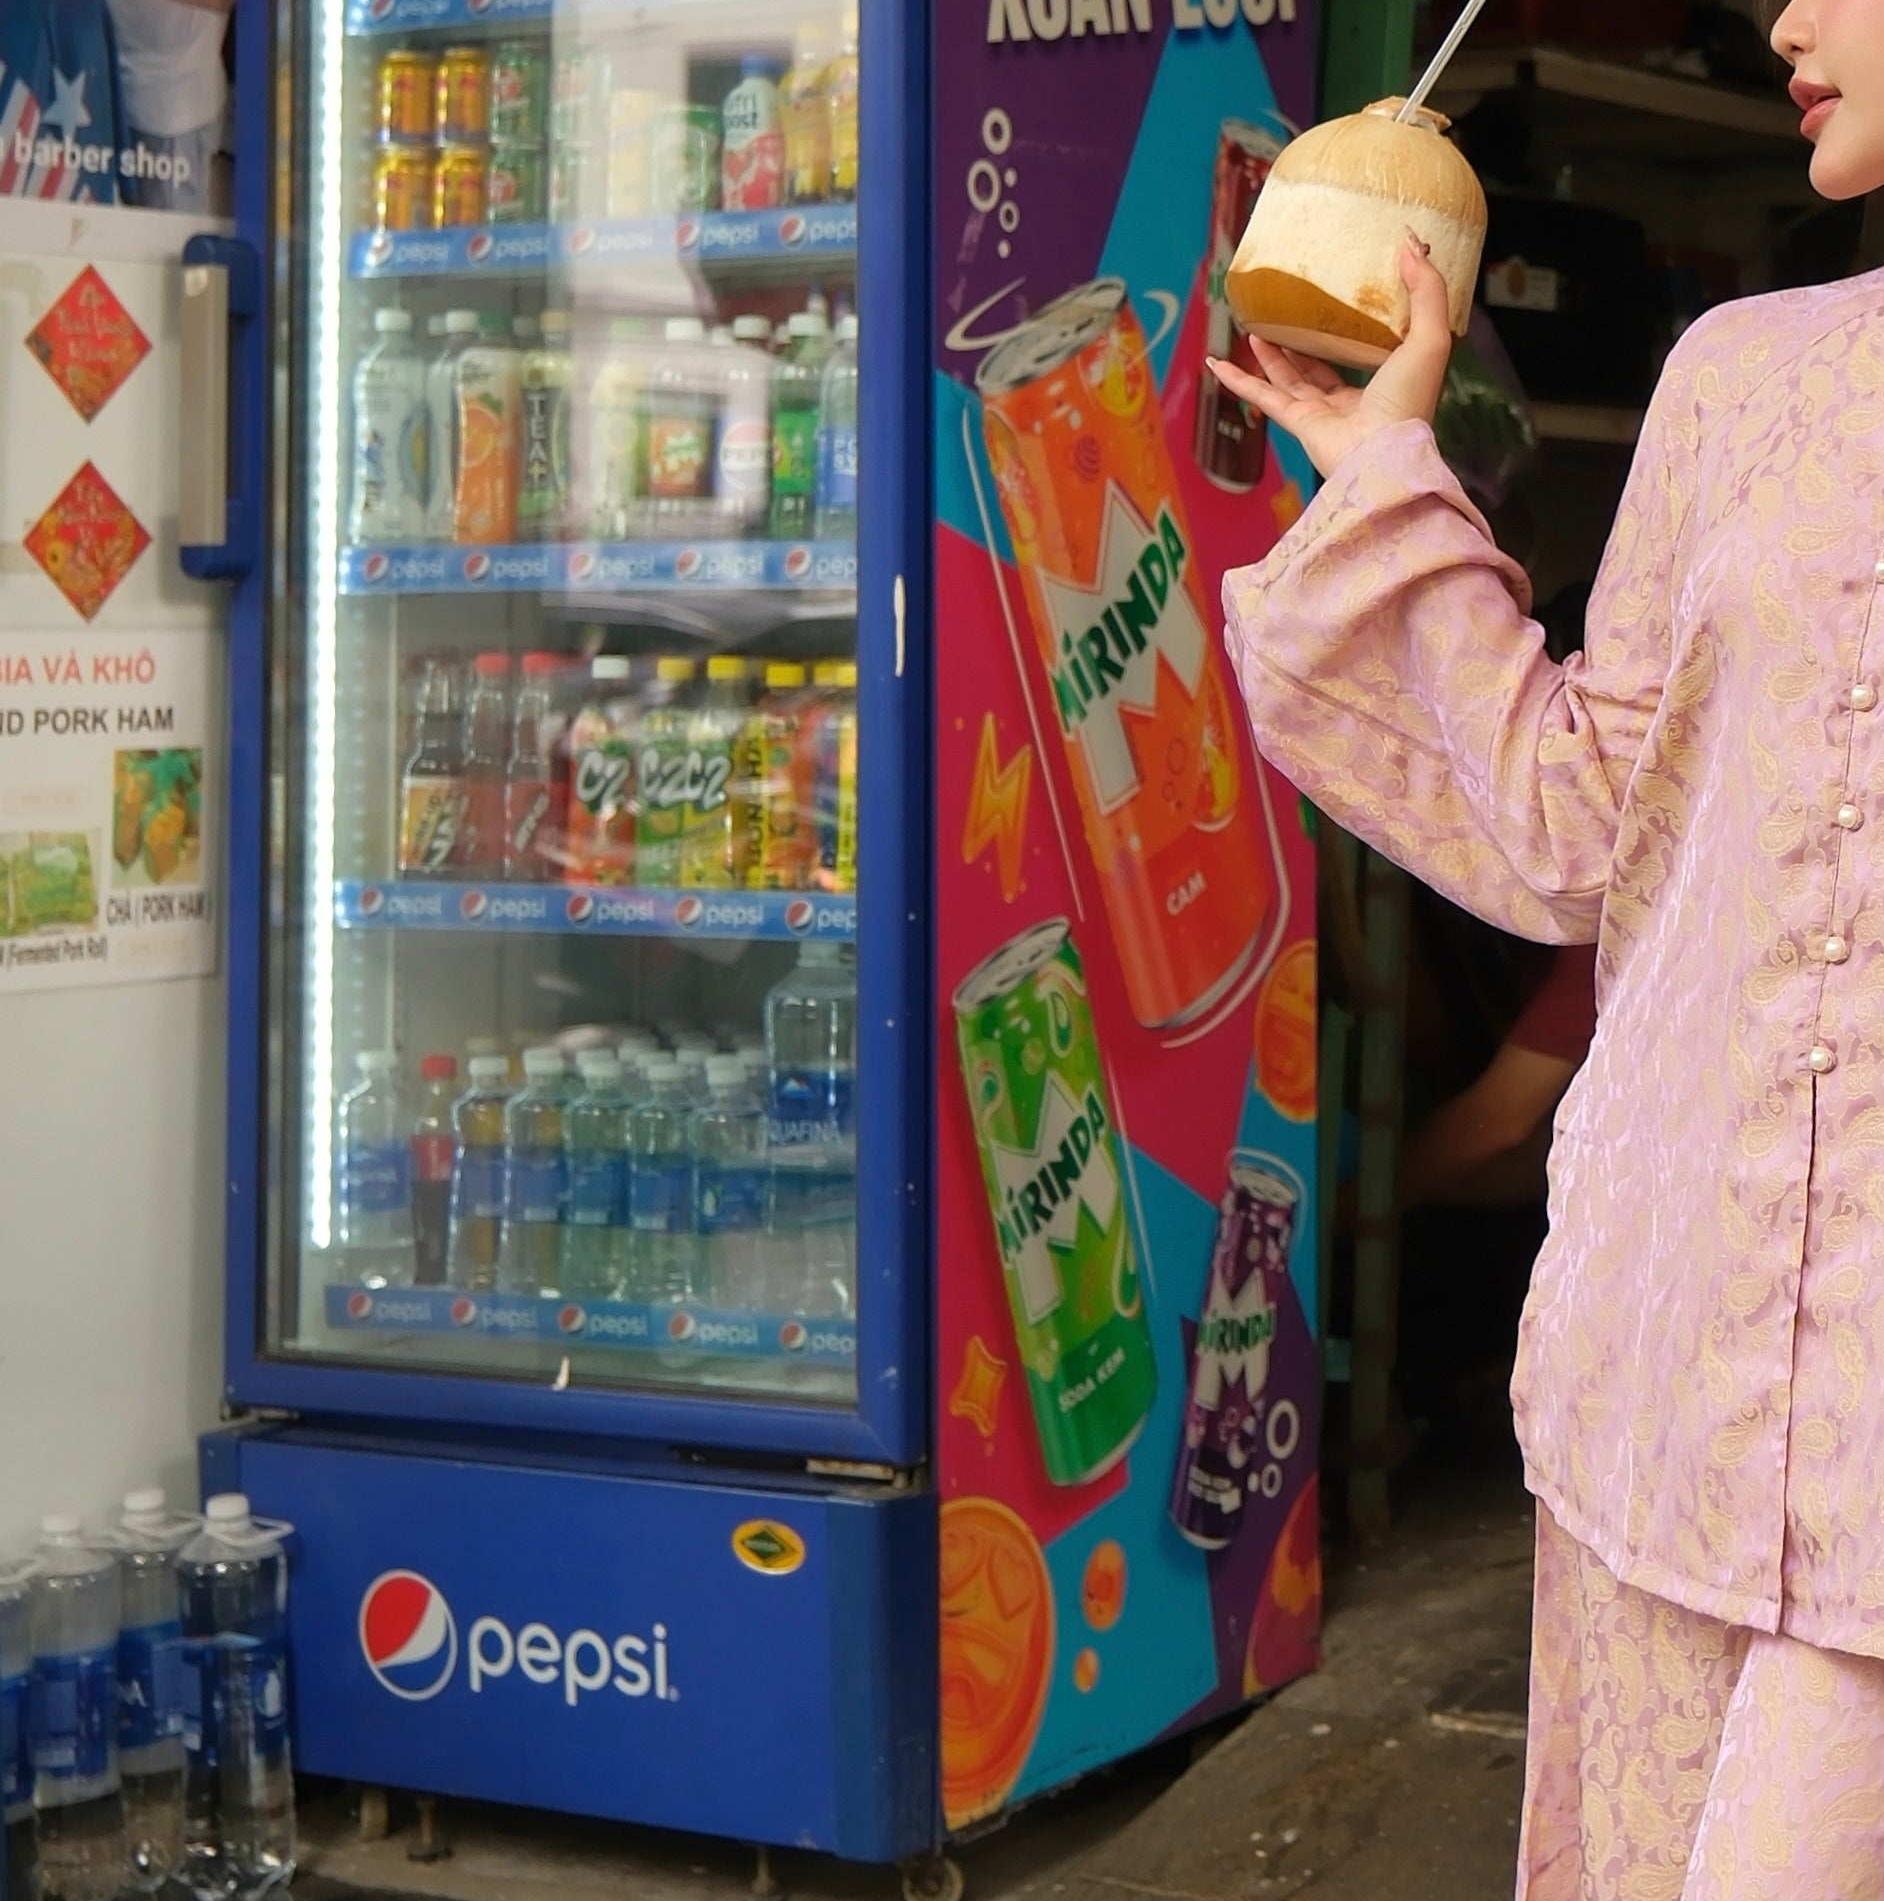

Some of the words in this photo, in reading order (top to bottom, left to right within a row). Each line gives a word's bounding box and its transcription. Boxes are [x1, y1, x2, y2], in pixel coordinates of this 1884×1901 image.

[14, 131, 113, 175] barber
[119, 141, 191, 191] shop
[703, 222, 760, 249] pepsi
[391, 556, 445, 580] pepsi
[492, 555, 549, 582] pepsi
[706, 551, 763, 577] pepsi
[43, 648, 83, 685] VÀ
[92, 649, 156, 685] KHÔ
[33, 707, 108, 735] PORK
[117, 705, 174, 733] HAM
[387, 896, 442, 917] pepsi
[1166, 870, 1207, 917] CAM
[490, 897, 546, 919] pepsi
[597, 899, 655, 923] pepsi
[706, 901, 764, 926] pepsi
[590, 1314, 649, 1337] pepsi
[700, 1321, 759, 1345] pepsi
[1057, 1375, 1097, 1414] SODA
[1098, 1346, 1127, 1385] KEM
[468, 1621, 669, 1708] pepsi
